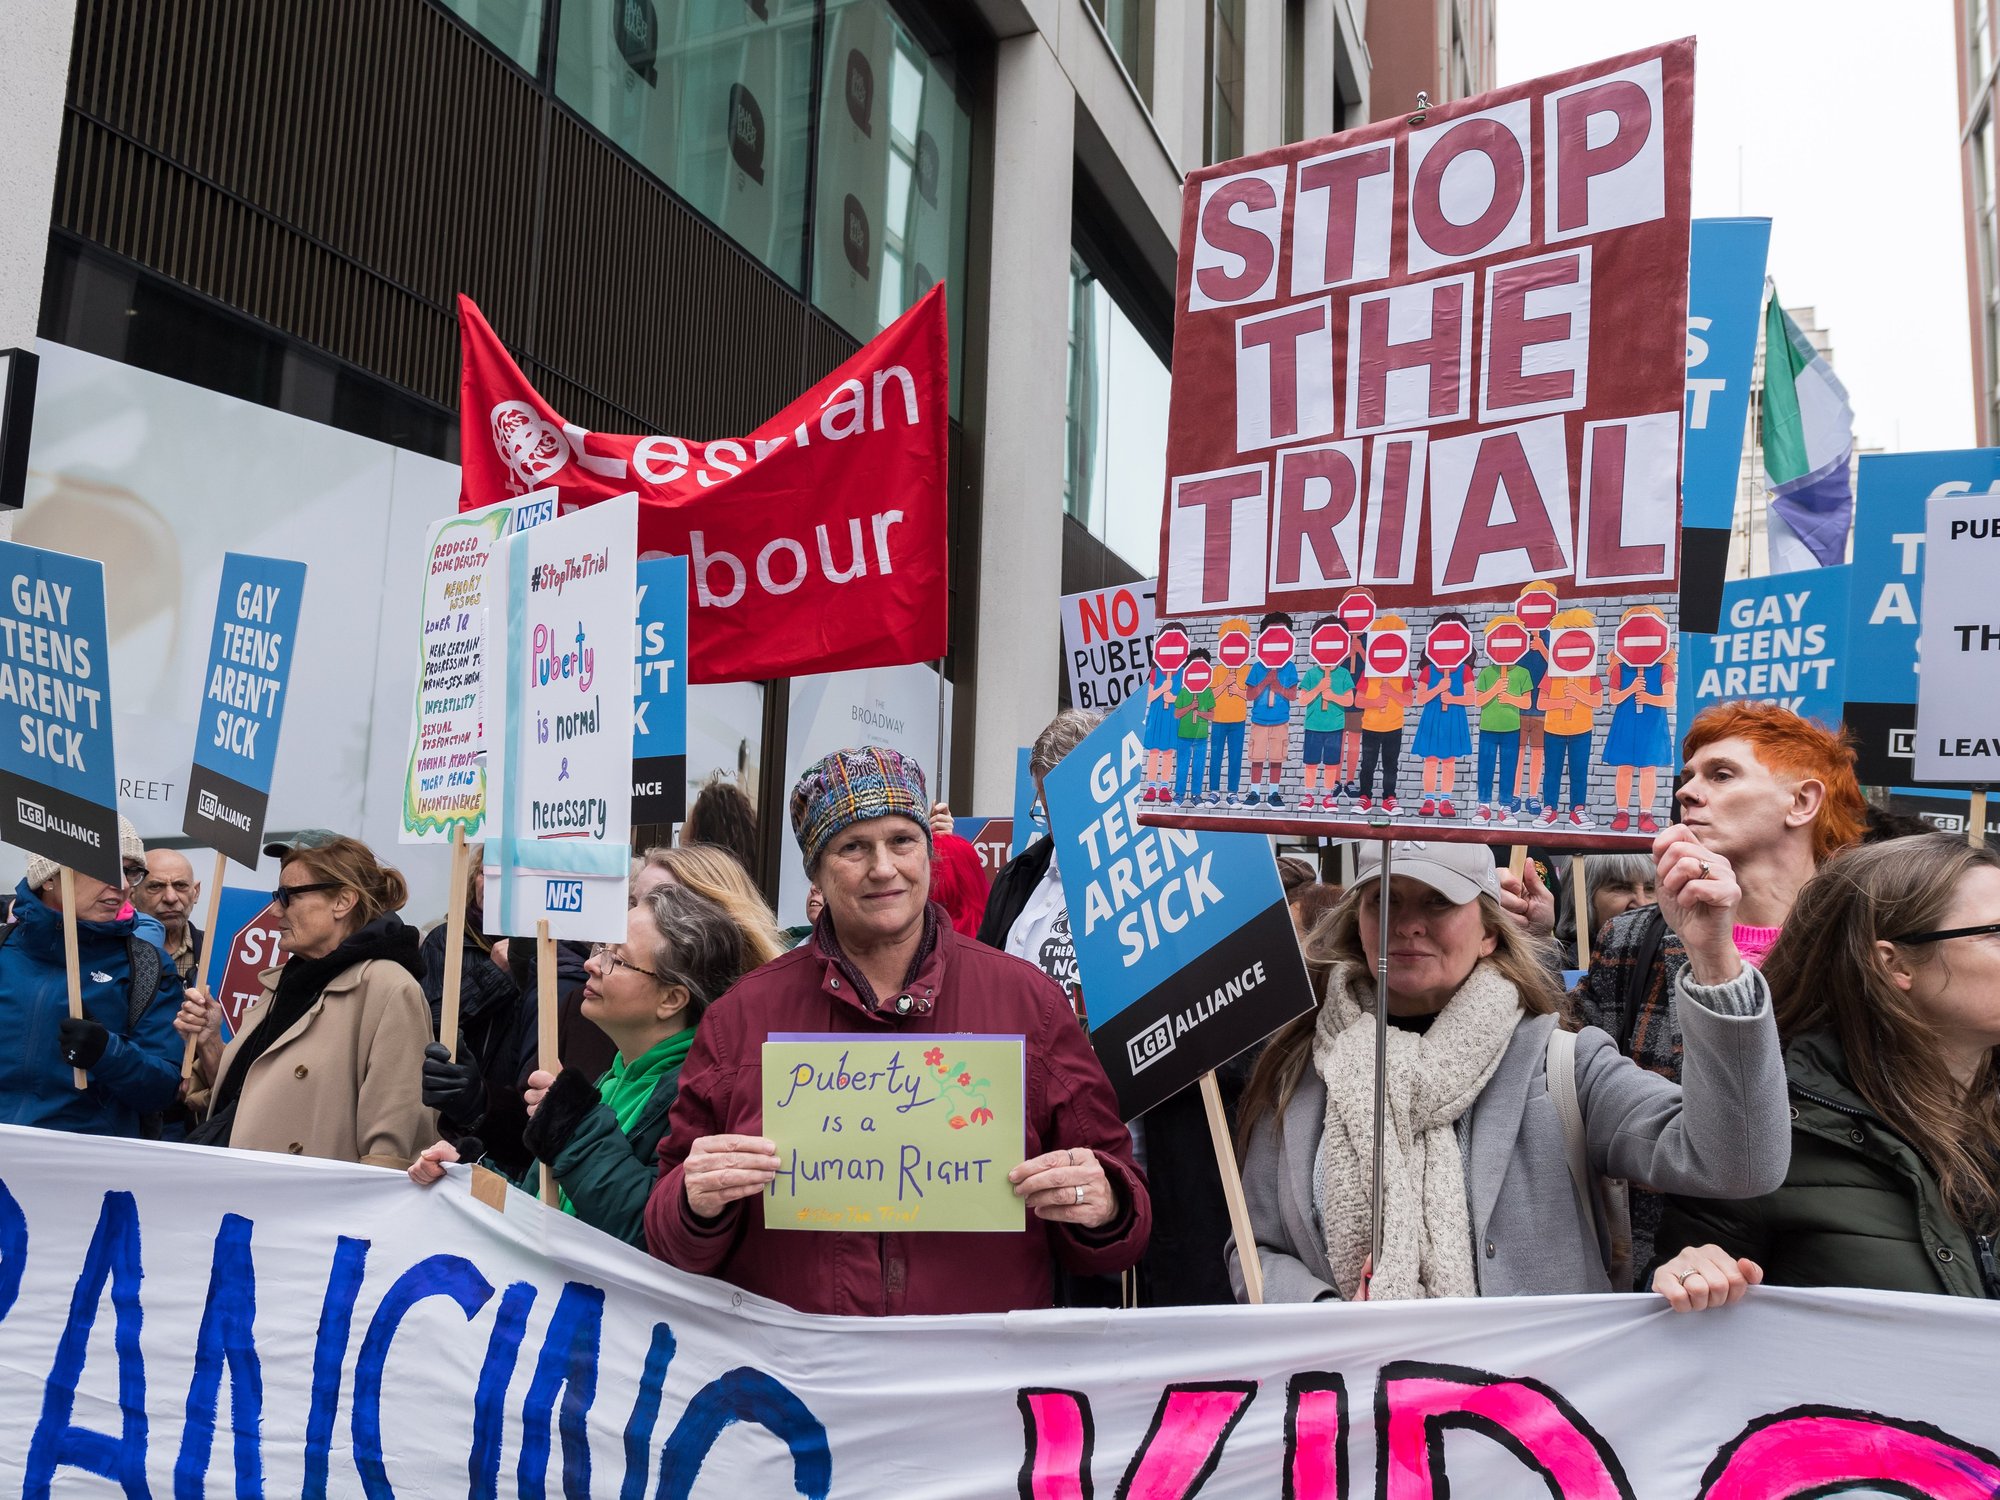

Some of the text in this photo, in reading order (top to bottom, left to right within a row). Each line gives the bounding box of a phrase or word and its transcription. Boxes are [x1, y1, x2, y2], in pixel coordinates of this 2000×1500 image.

[1196, 80, 1652, 302] STOP
[1241, 253, 1581, 440] THE
[563, 365, 919, 488] Lesan
[517, 500, 552, 531] NHS
[1177, 423, 1666, 605] TRIAL
[434, 537, 479, 559] REDUCED
[531, 546, 609, 597] #StopTheTrial
[638, 508, 905, 609] bour
[11, 574, 72, 626] GAY
[236, 581, 281, 624] GAY
[444, 574, 482, 600] MEMORY
[1730, 590, 1812, 629] GAY
[425, 613, 470, 635] LOWER IQ
[1078, 588, 1139, 645] NO
[0, 616, 91, 680] TEENS
[222, 622, 283, 672] TEENS
[447, 636, 480, 657] CERTAIN
[531, 620, 595, 693] Puberty
[1710, 624, 1828, 664] TEENS
[0, 662, 101, 731] AREN'T
[208, 664, 281, 719] AREN'T
[1695, 658, 1836, 699] AREN'T
[425, 693, 477, 715] INFERTILITY
[537, 709, 549, 745] is
[556, 694, 600, 743] normal
[851, 704, 905, 735] BROADWAY
[19, 714, 87, 772] SICK
[213, 710, 261, 760] SICK
[421, 720, 453, 738] SEXUAL
[119, 778, 175, 802] REET
[420, 770, 476, 792] MICRO PENIS
[1090, 730, 1145, 804] GA
[215, 800, 251, 832] ALLIANCE
[417, 792, 482, 815] INCONTINENCE
[532, 798, 607, 841] necessary
[47, 814, 101, 848] ALLIANCE
[546, 881, 582, 910] NHS
[1085, 827, 1200, 937] AREN
[1117, 850, 1225, 968] SICK
[1133, 960, 1267, 1064] LGB ALLIANCE
[860, 1116, 877, 1133] a
[769, 1148, 885, 1197] Human
